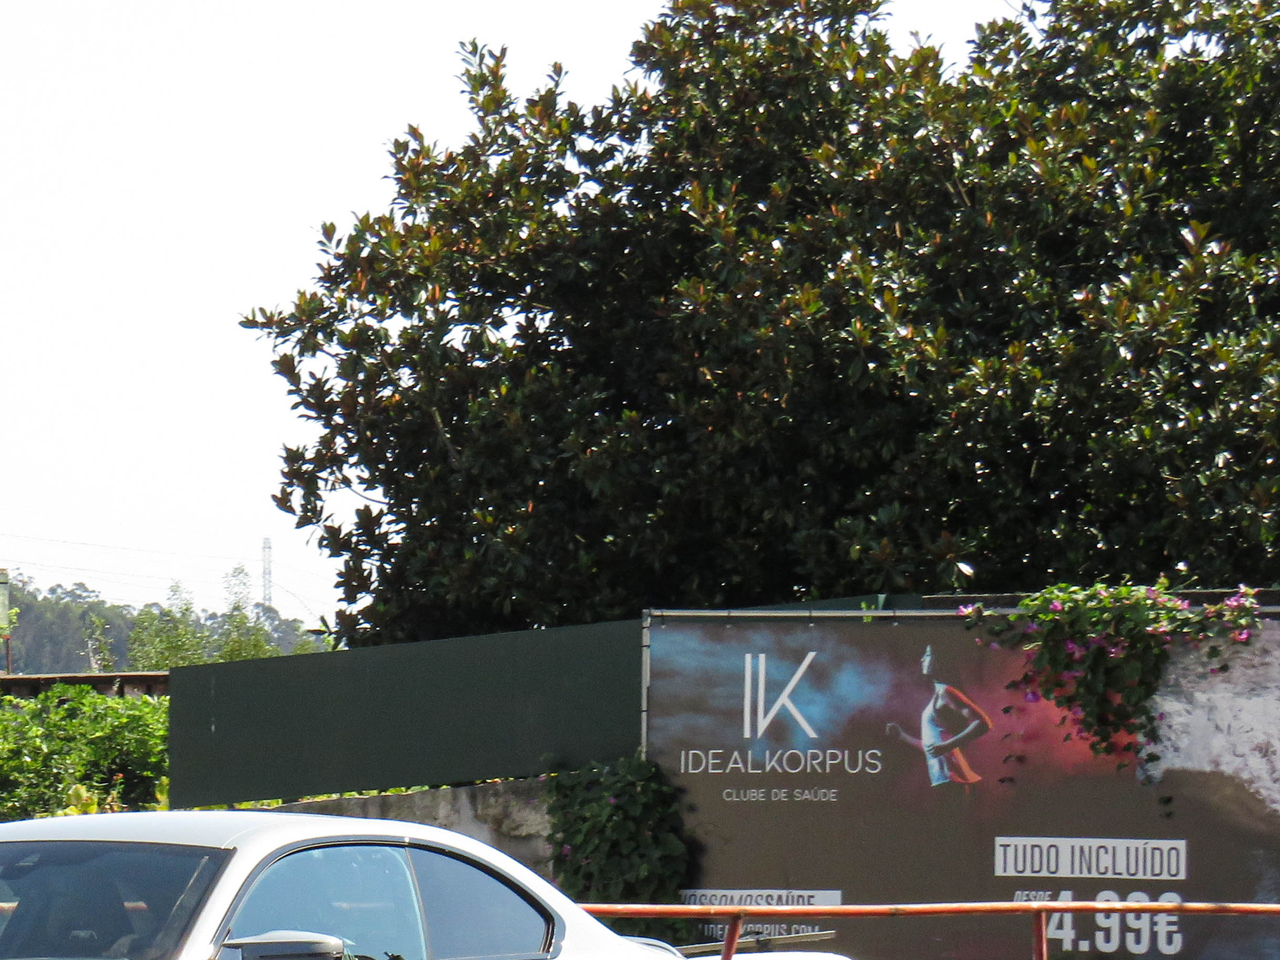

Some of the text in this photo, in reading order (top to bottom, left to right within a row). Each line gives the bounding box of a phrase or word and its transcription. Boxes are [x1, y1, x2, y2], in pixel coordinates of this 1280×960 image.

[680, 749, 882, 774] IDEALKORPUS
[722, 786, 838, 801] CLUBE DE SAÚDE
[999, 841, 1180, 878] TUDO INCLUÍDO
[1046, 890, 1183, 955] 4.99€
